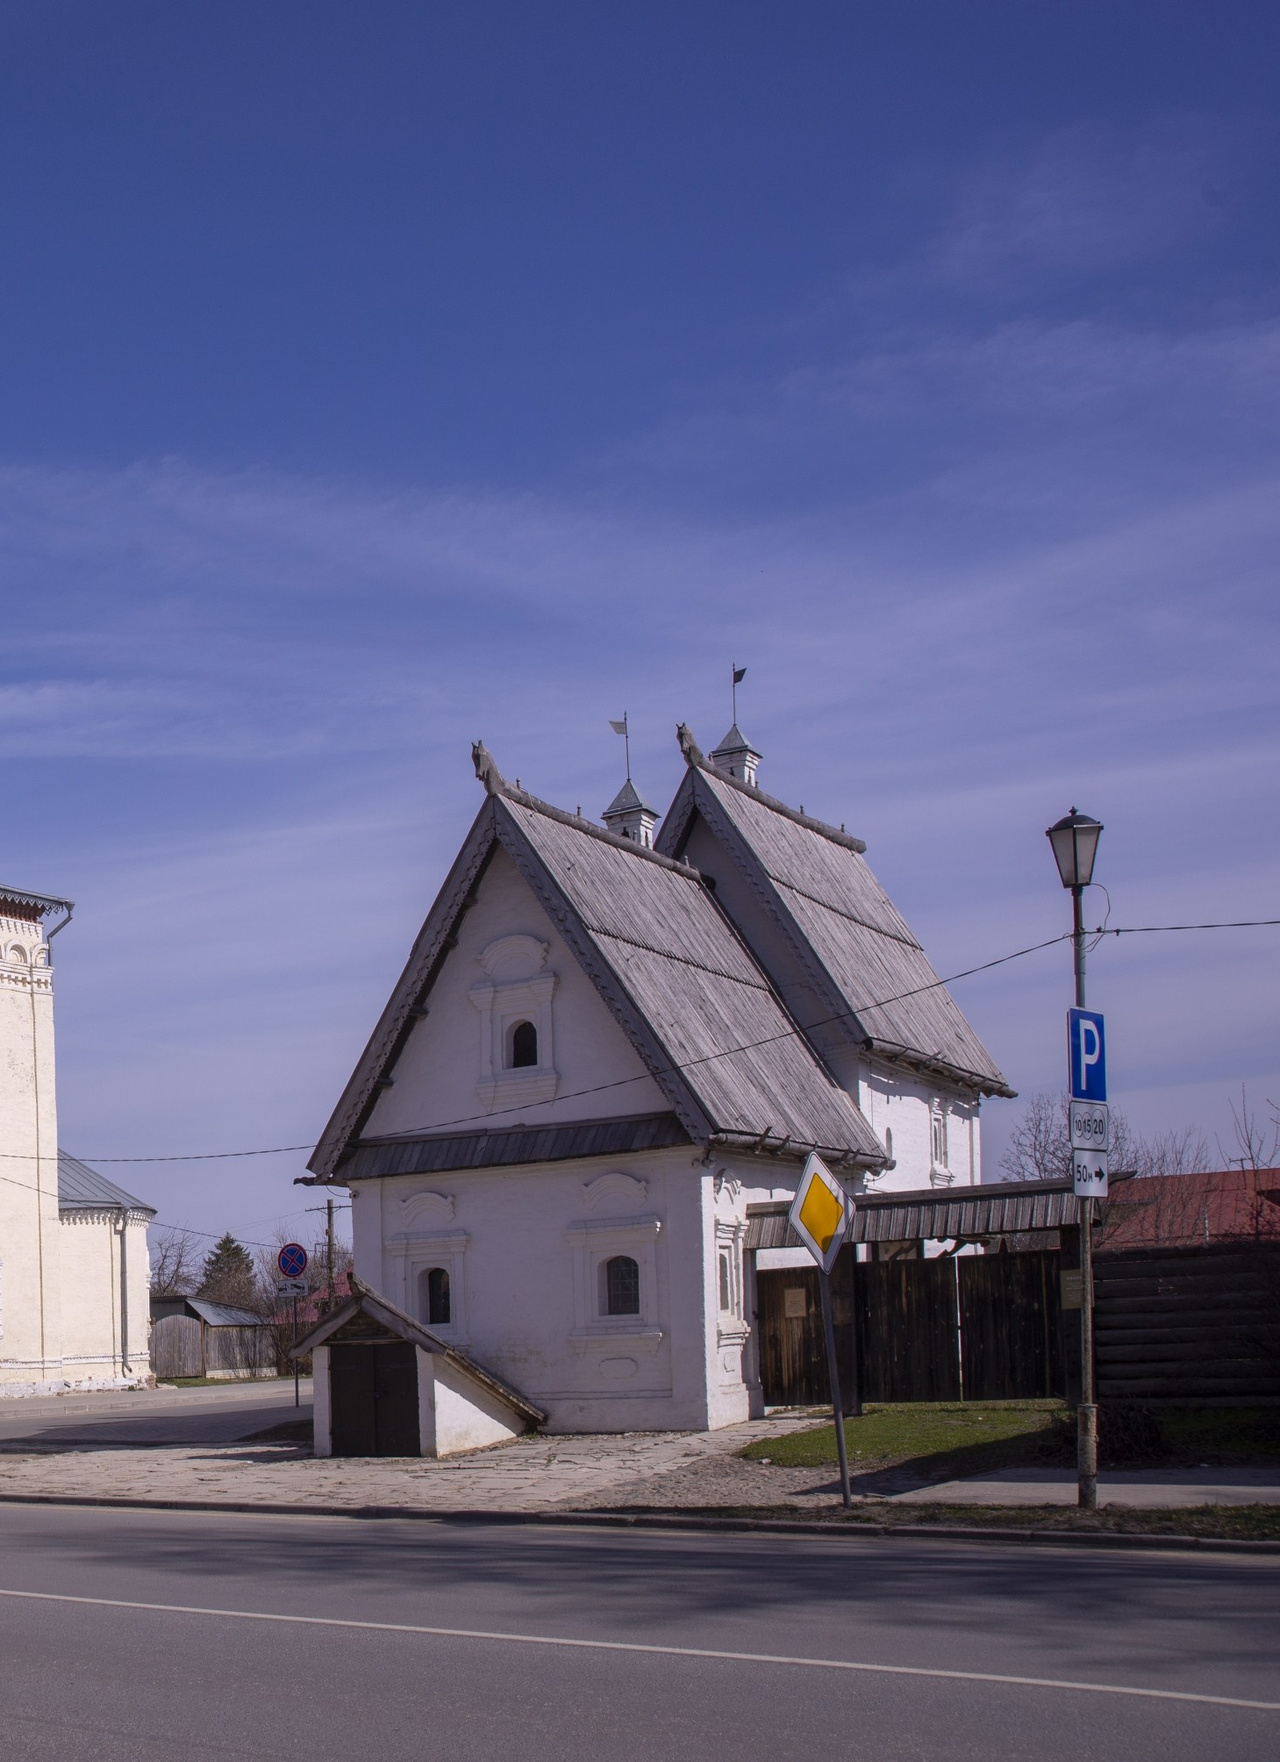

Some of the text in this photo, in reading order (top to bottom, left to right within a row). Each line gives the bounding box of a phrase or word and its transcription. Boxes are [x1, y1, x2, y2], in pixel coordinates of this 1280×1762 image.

[1079, 1019, 1100, 1091] P
[1075, 1119, 1104, 1135] 10 15 20
